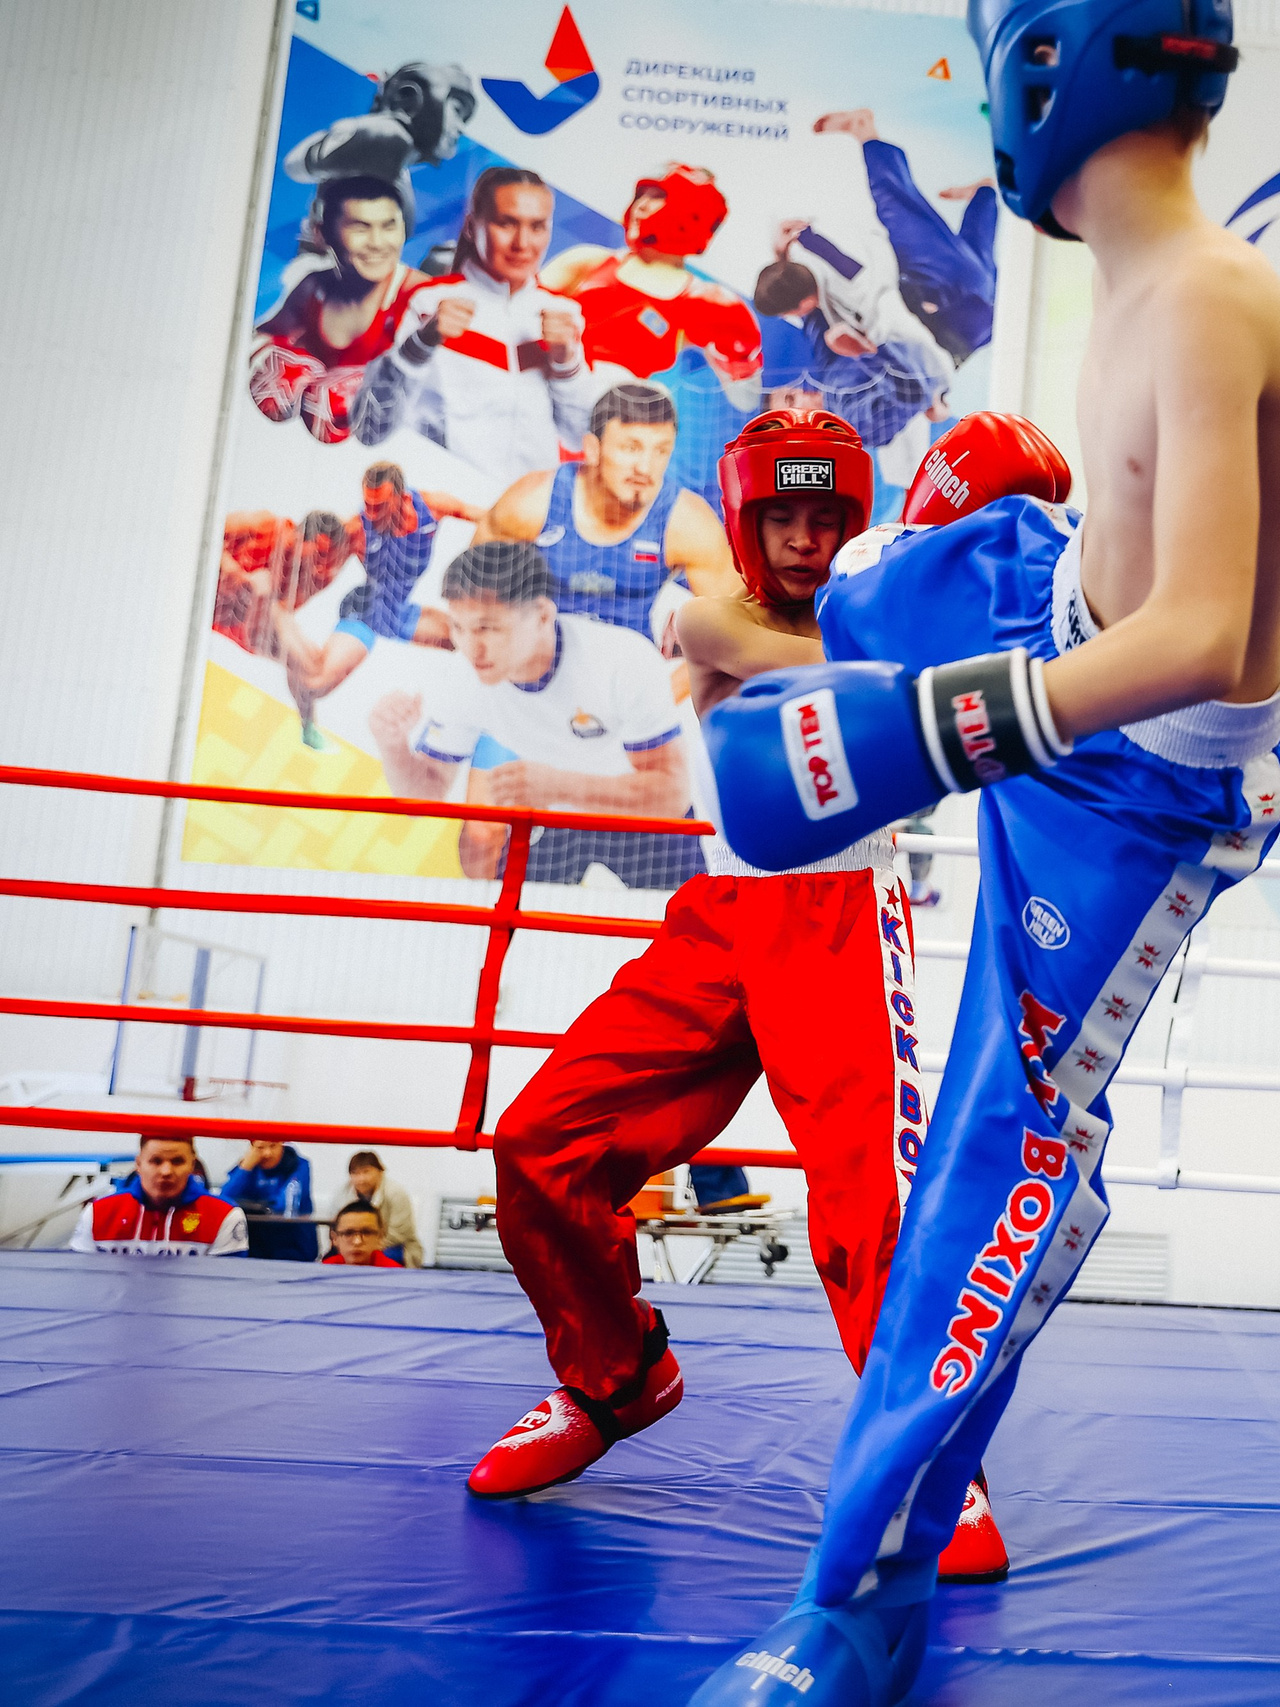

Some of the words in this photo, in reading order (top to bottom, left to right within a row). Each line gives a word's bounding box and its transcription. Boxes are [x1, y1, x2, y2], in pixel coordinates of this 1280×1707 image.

[625, 59, 756, 84] ДИРЕКЦИЯ
[622, 86, 789, 114] СПОРТИВНЫХ
[619, 112, 789, 141] СООРУЖЕНИЙ
[781, 464, 829, 475] GREEN
[783, 473, 823, 485] HILL
[924, 448, 970, 510] clinch
[808, 756, 839, 807] TOP
[881, 907, 920, 1074] KICK
[898, 1080, 923, 1183] BO
[930, 1126, 1068, 1398] BOXING
[735, 1650, 815, 1694] clinch
